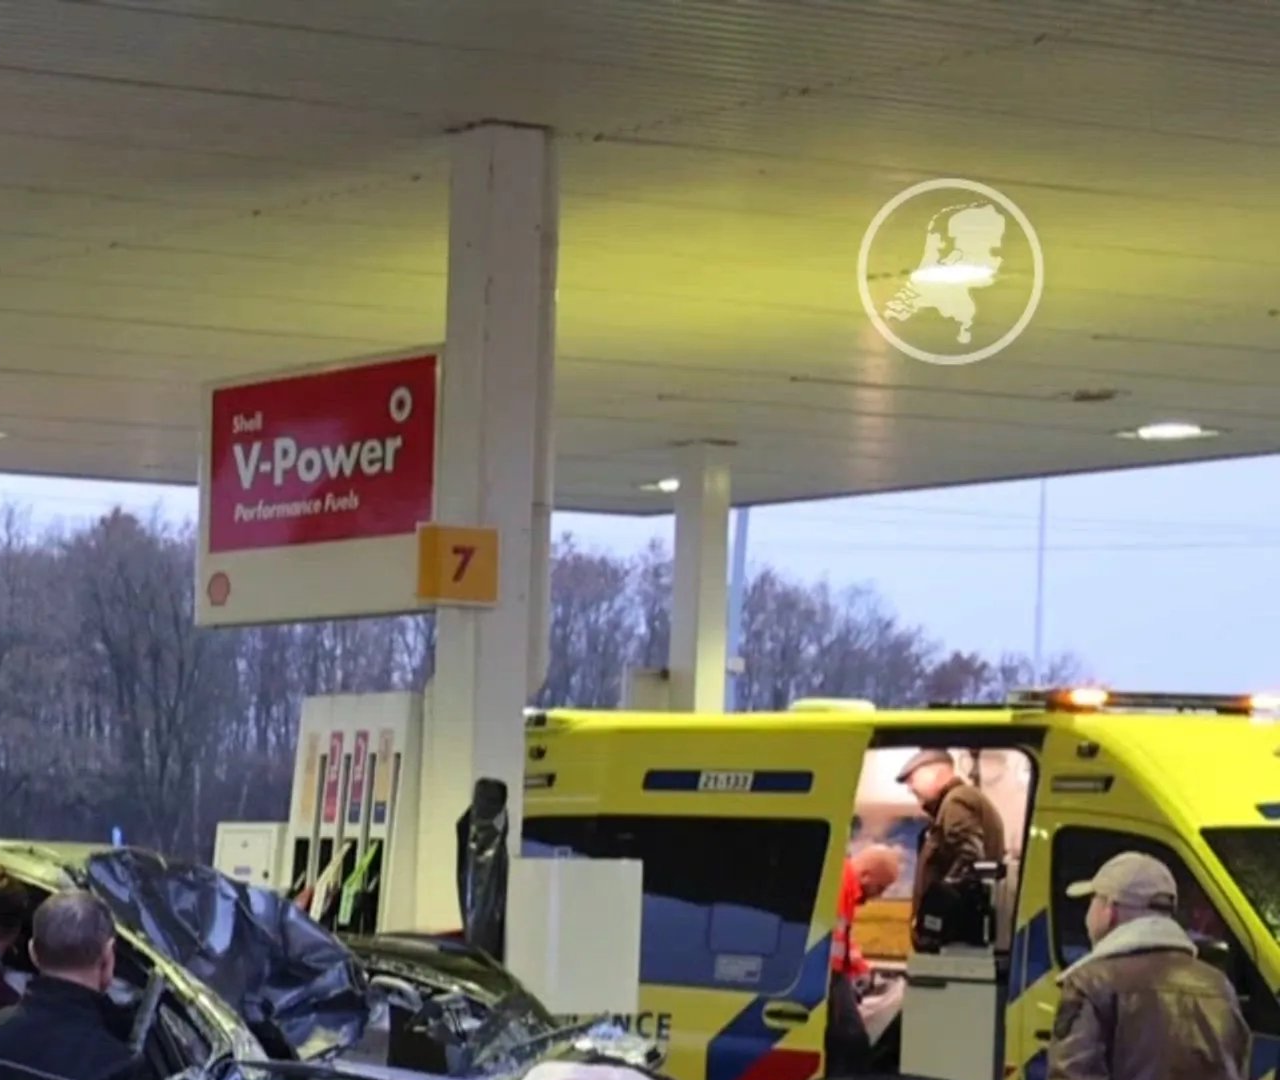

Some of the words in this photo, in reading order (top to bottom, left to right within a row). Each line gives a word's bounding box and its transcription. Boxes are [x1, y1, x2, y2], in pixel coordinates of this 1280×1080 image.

[233, 412, 263, 433] Shell
[234, 435, 402, 490] V-Power
[234, 500, 323, 522] Performance
[324, 490, 360, 512] Fuels
[451, 545, 476, 582] 7
